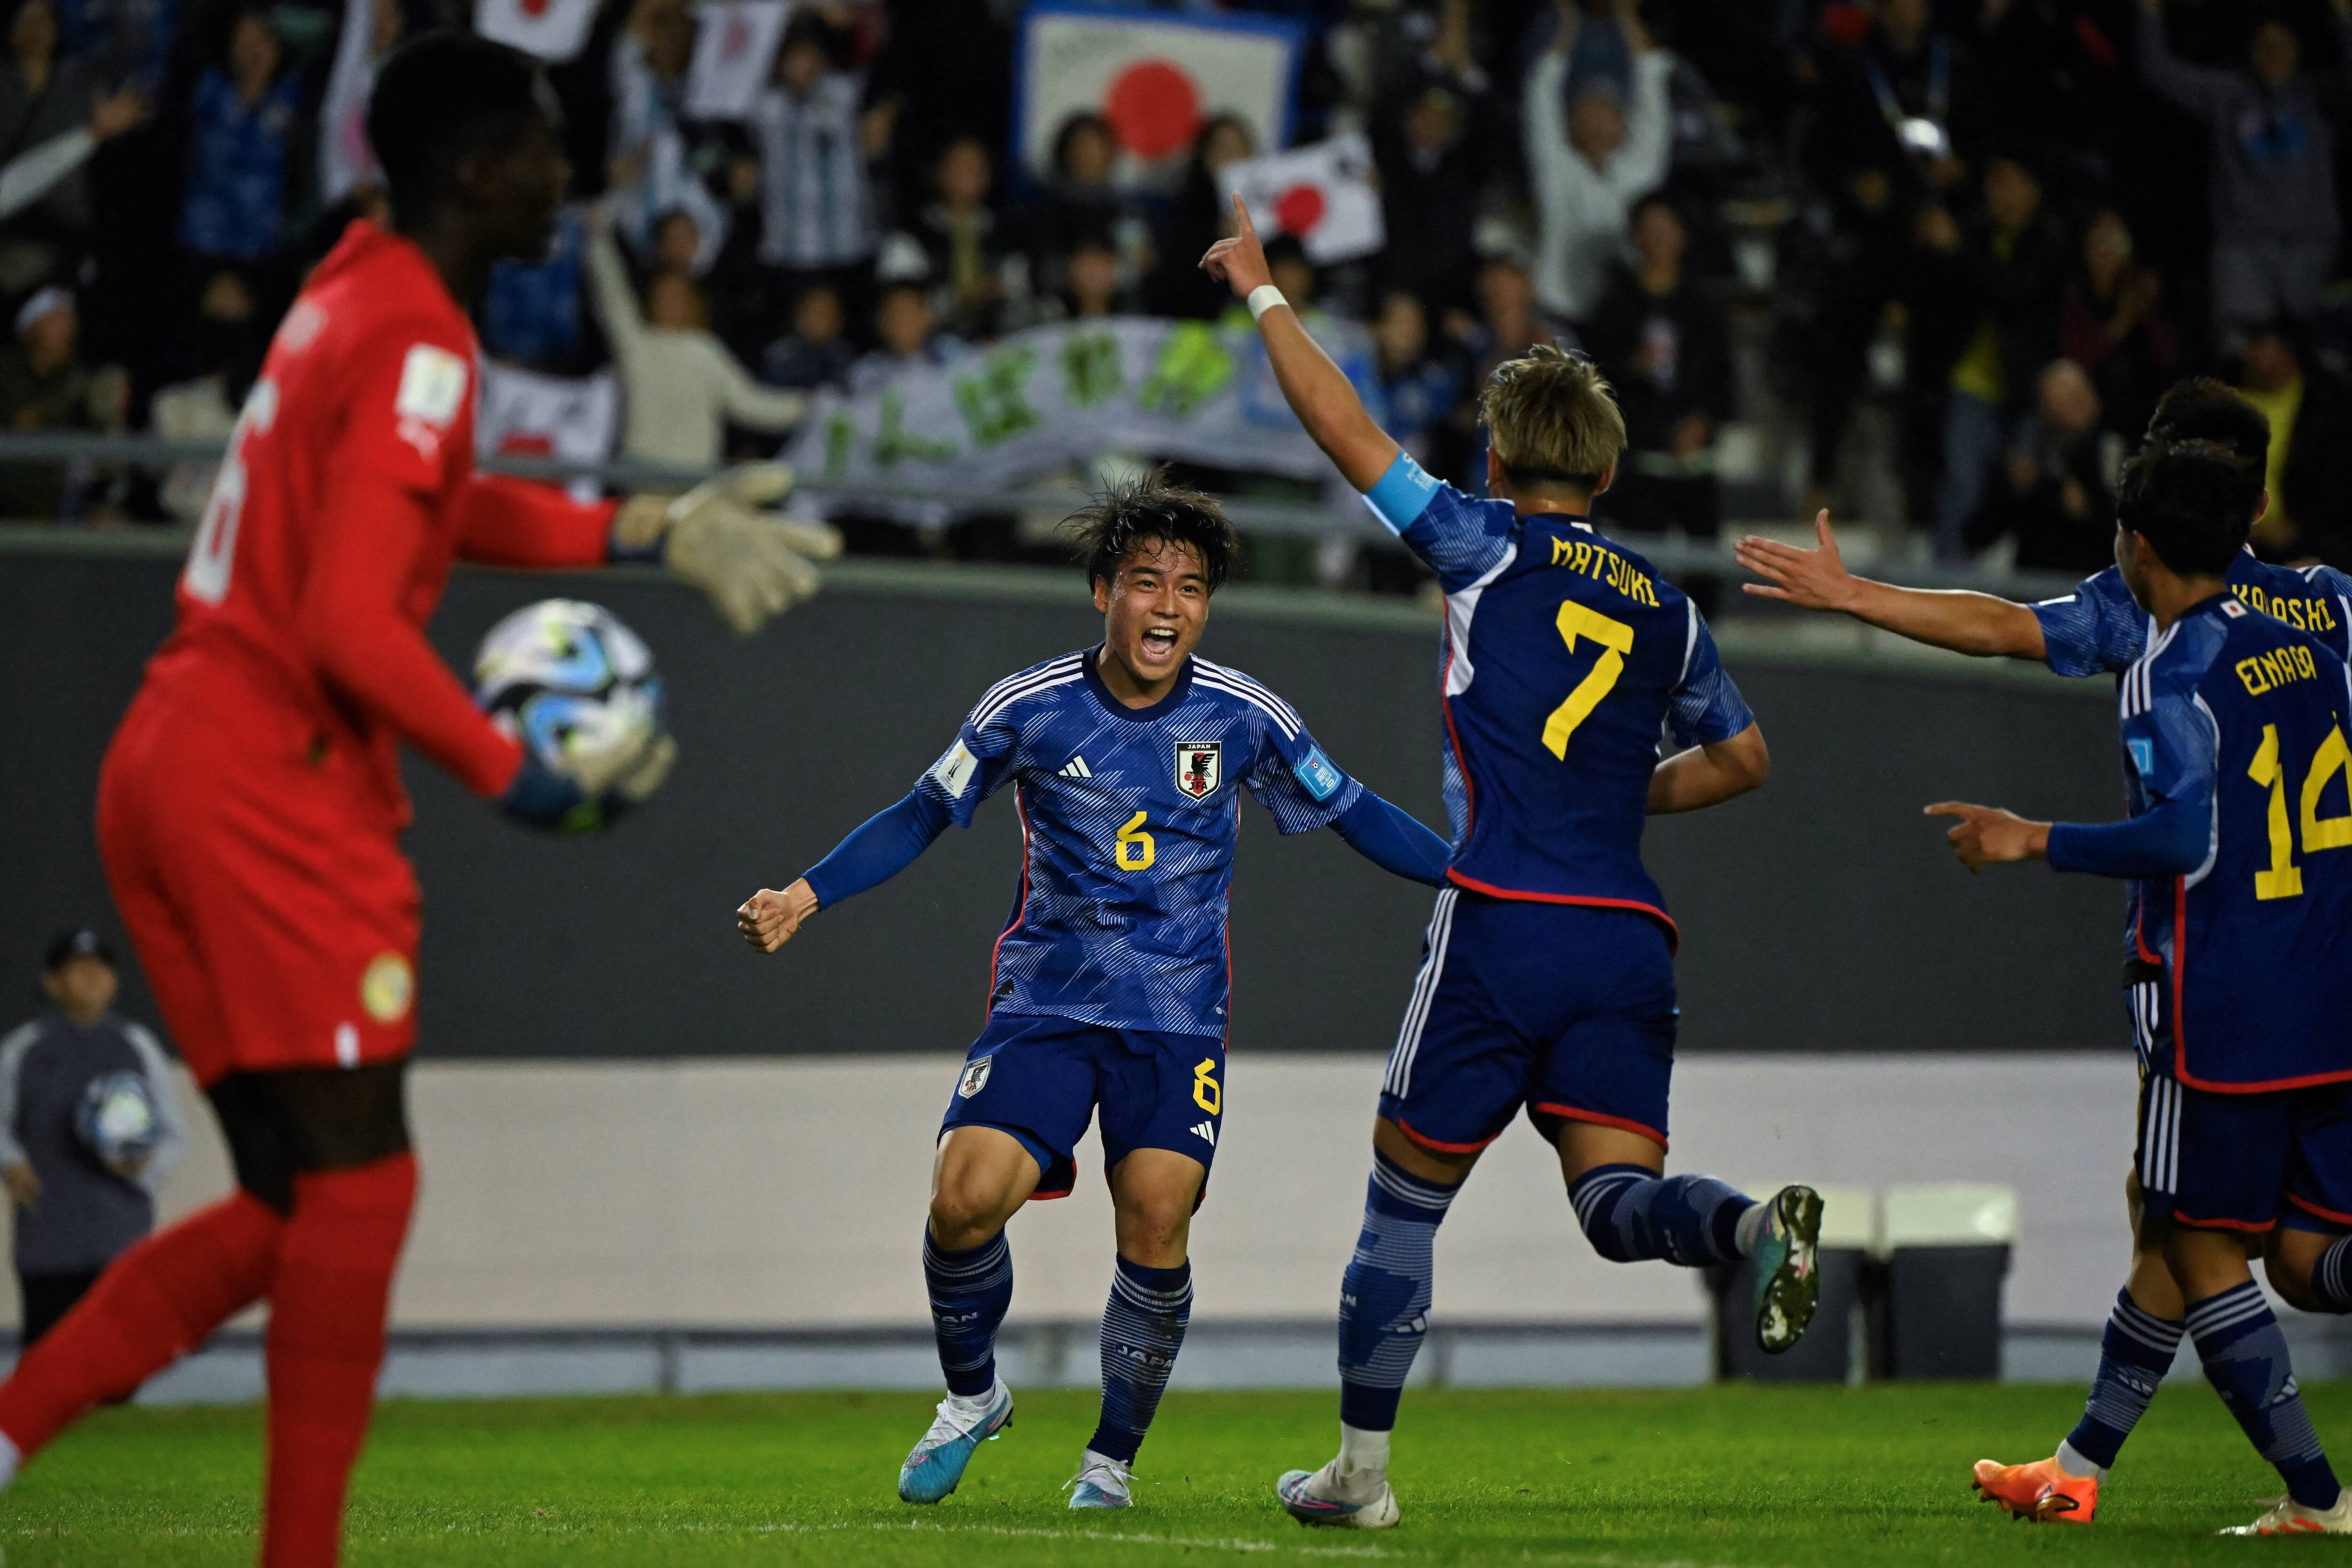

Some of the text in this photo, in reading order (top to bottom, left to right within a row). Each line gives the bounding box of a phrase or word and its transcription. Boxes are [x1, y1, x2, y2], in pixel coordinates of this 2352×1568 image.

[1552, 536, 1660, 607] MATSUKI
[1542, 600, 1635, 761] 7
[2236, 645, 2317, 696] EINAGA
[1189, 781, 1208, 790] JFA
[1317, 770, 1329, 782] UNITES
[2248, 712, 2352, 900] 14
[1116, 812, 1155, 871] 6
[1193, 1058, 1221, 1116] 6
